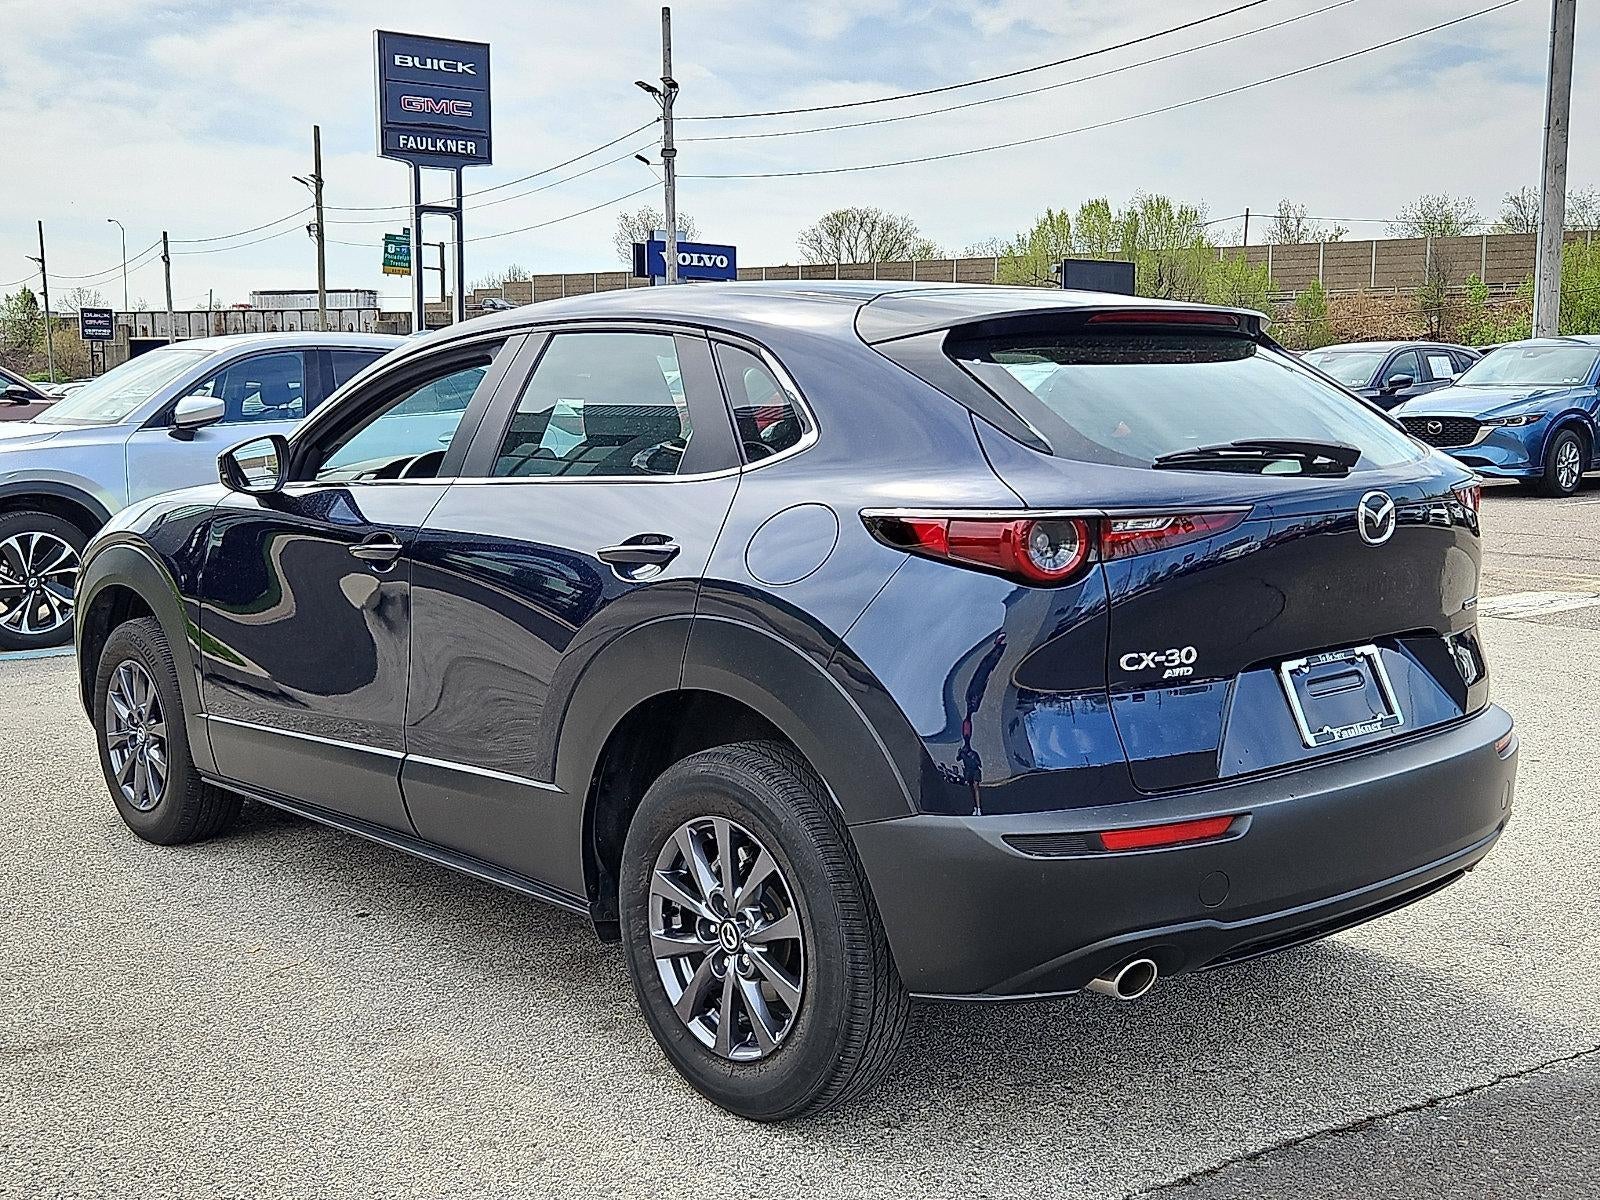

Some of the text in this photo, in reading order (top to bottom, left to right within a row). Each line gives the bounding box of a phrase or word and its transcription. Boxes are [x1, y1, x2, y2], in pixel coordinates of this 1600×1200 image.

[393, 54, 477, 76] BUICK
[401, 95, 473, 117] GMC
[399, 135, 476, 155] FAULKNER
[1119, 646, 1198, 671] CX-30
[1162, 666, 1194, 679] AWD
[1333, 722, 1382, 740] Faulkner
